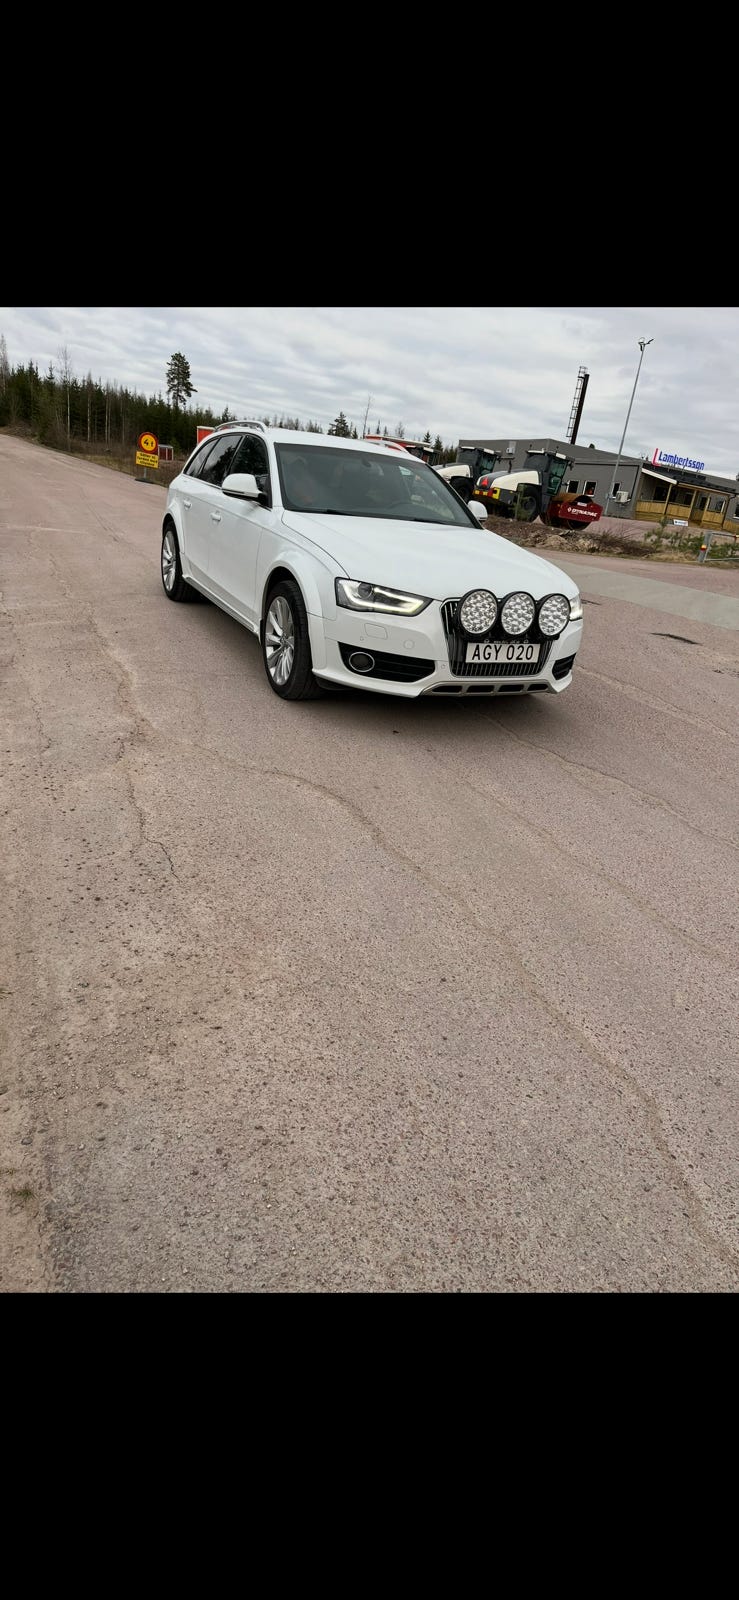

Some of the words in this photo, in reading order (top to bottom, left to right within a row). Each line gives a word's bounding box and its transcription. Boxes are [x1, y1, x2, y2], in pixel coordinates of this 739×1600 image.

[658, 451, 705, 470] Lambertsson
[472, 644, 502, 661] AGY
[506, 645, 534, 660] 020
